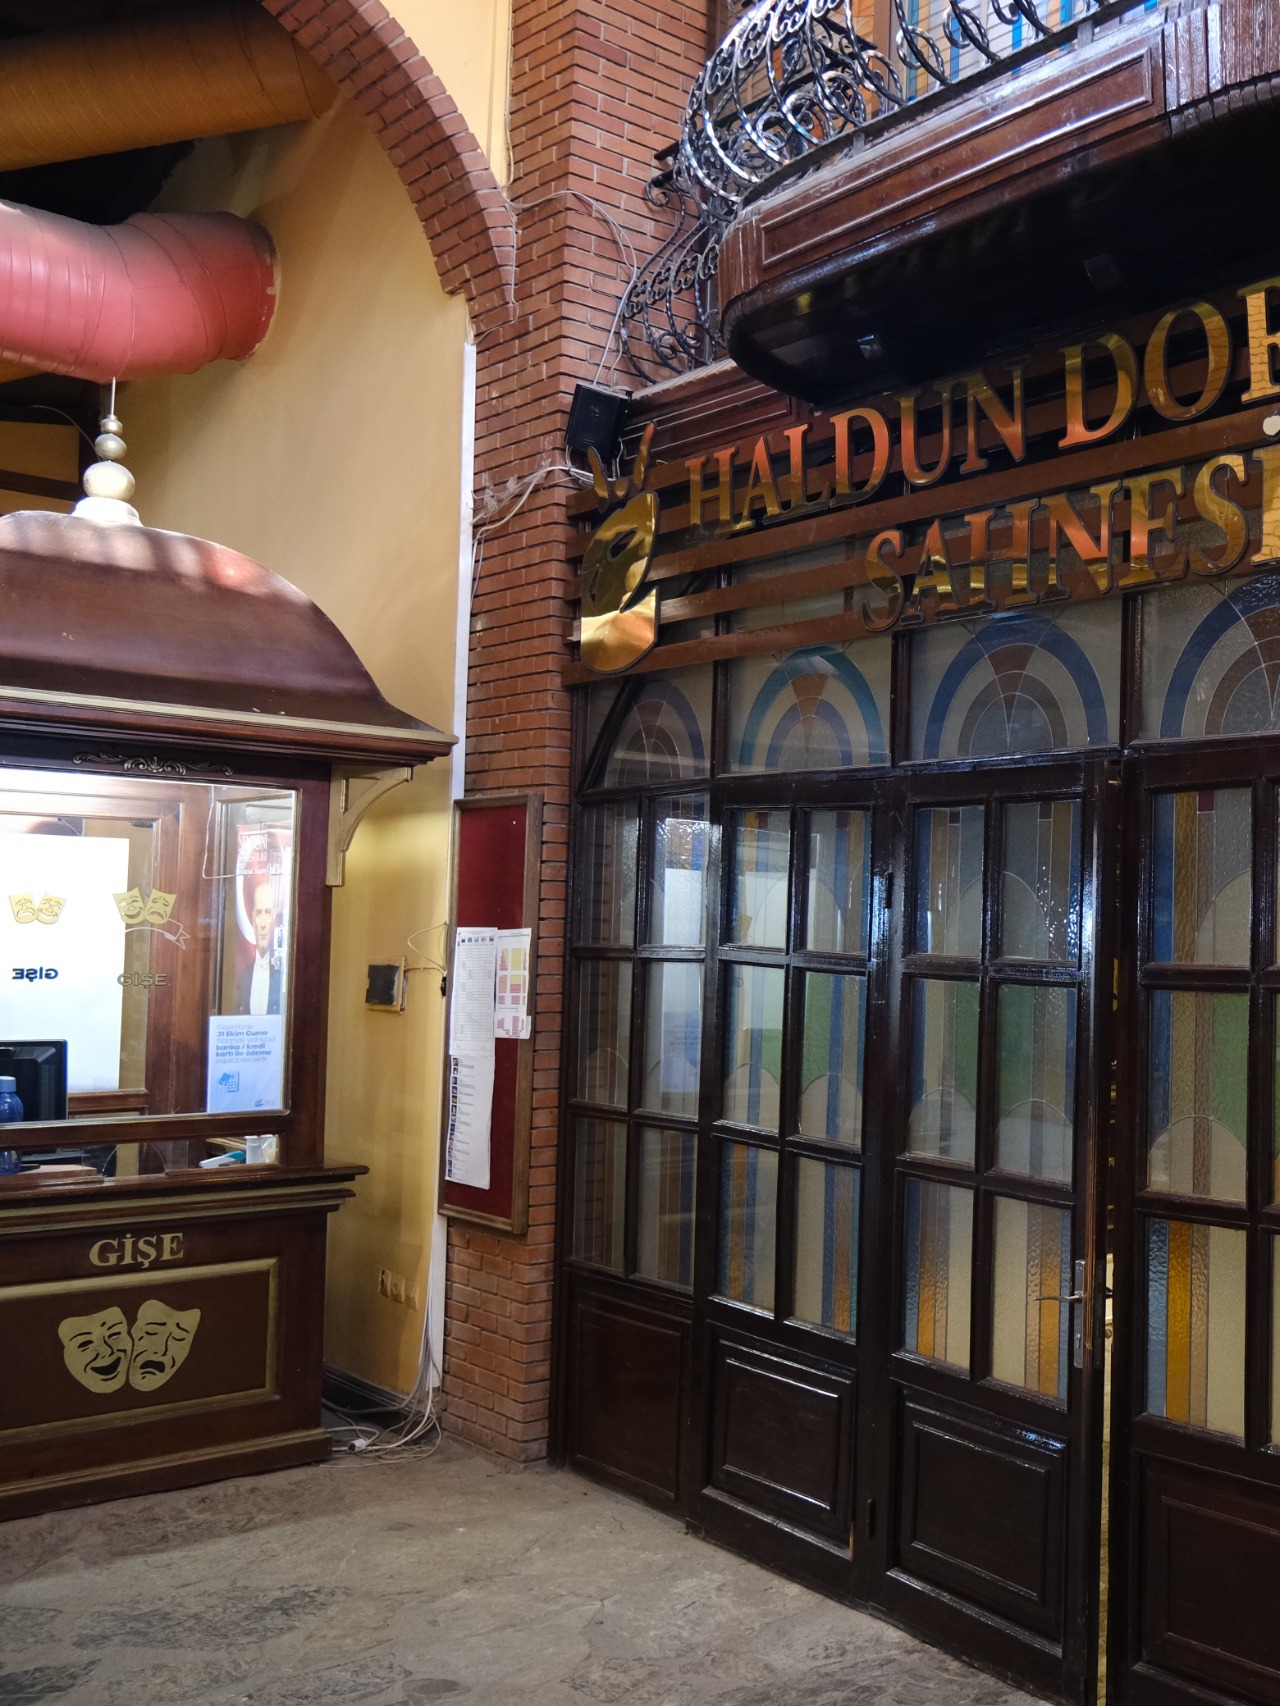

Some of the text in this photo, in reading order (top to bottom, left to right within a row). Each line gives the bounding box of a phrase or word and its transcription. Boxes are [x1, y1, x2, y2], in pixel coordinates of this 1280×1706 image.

[684, 355, 1031, 544] HALDUN
[117, 971, 168, 989] GİŞE
[89, 1233, 184, 1269] GİŞE
